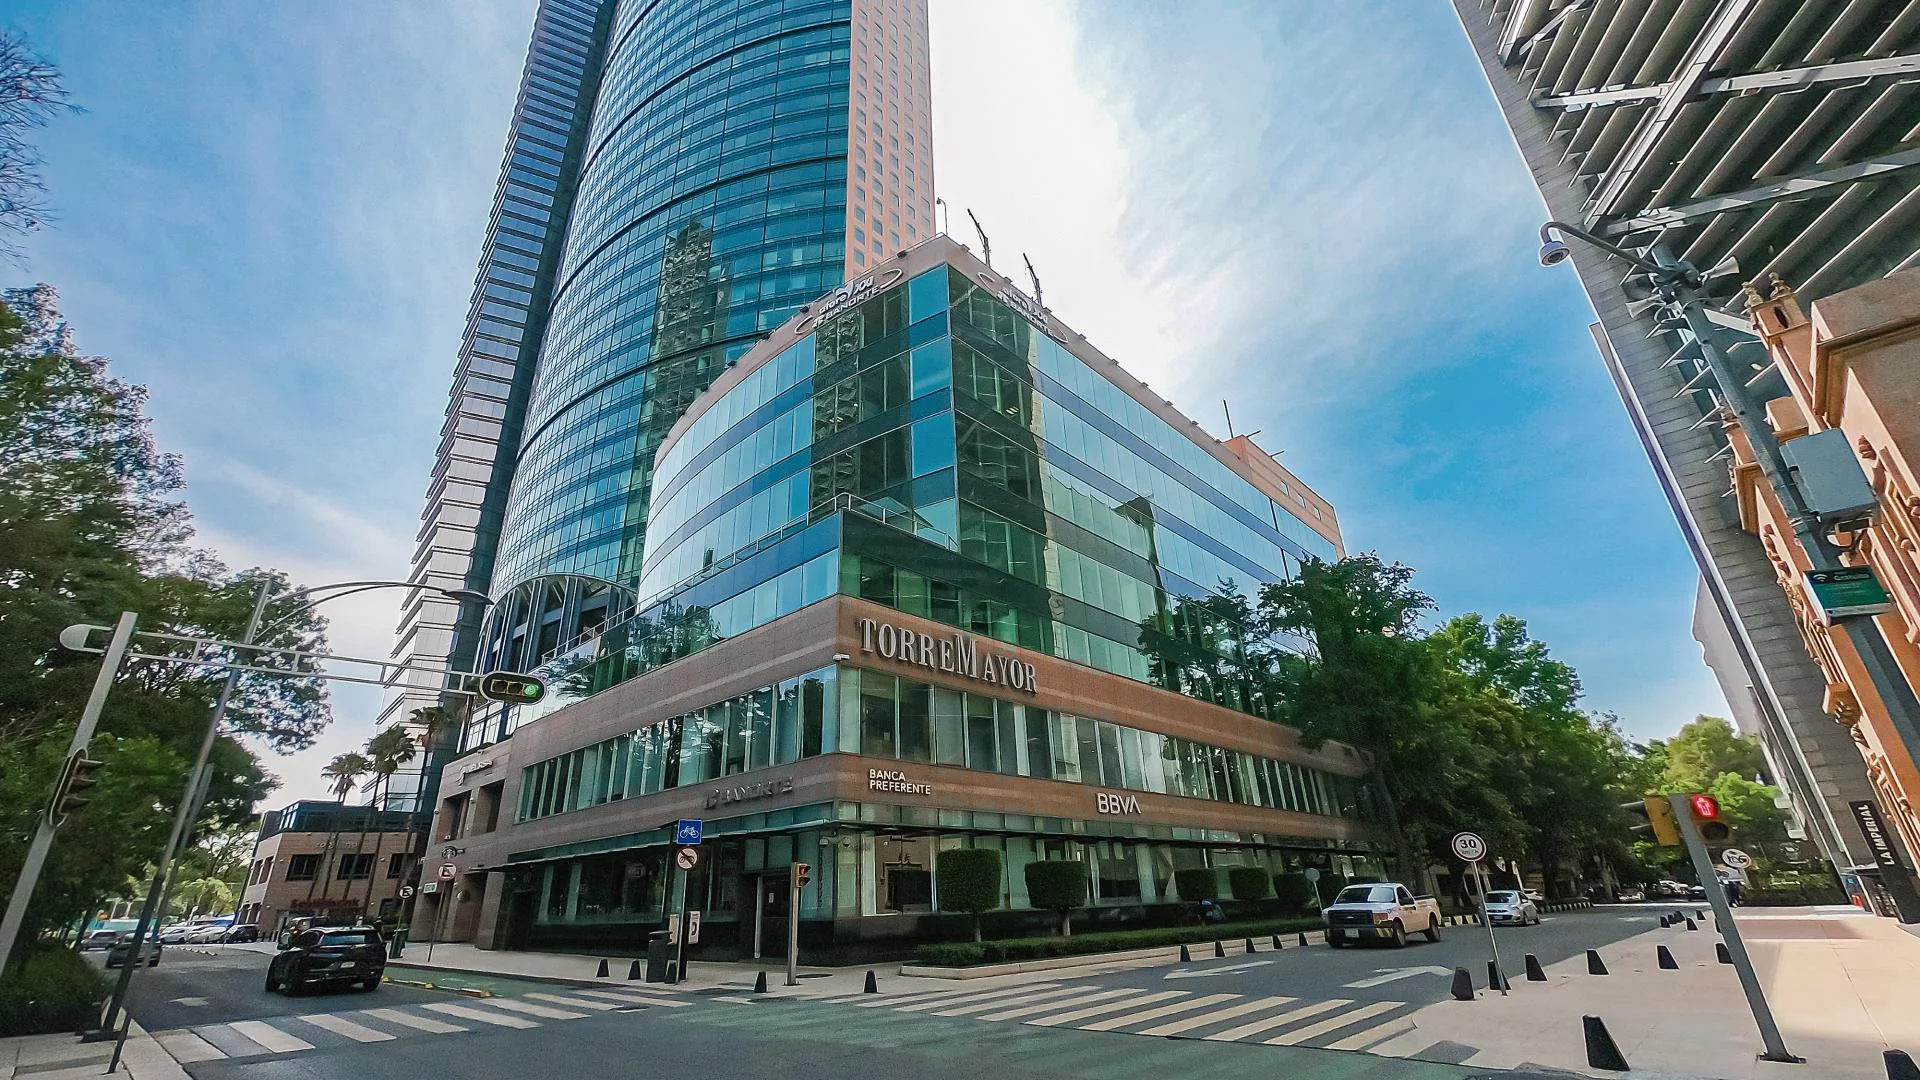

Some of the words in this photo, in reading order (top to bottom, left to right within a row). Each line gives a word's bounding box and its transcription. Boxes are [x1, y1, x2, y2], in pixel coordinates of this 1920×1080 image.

[825, 286, 880, 319] BANORTE
[869, 768, 906, 781] BANCA
[870, 780, 931, 795] PREFERENTE
[1096, 792, 1142, 816] BBVA
[1858, 804, 1889, 851] IMPERIAL
[1459, 839, 1477, 849] 30
[1880, 851, 1896, 866] LA
